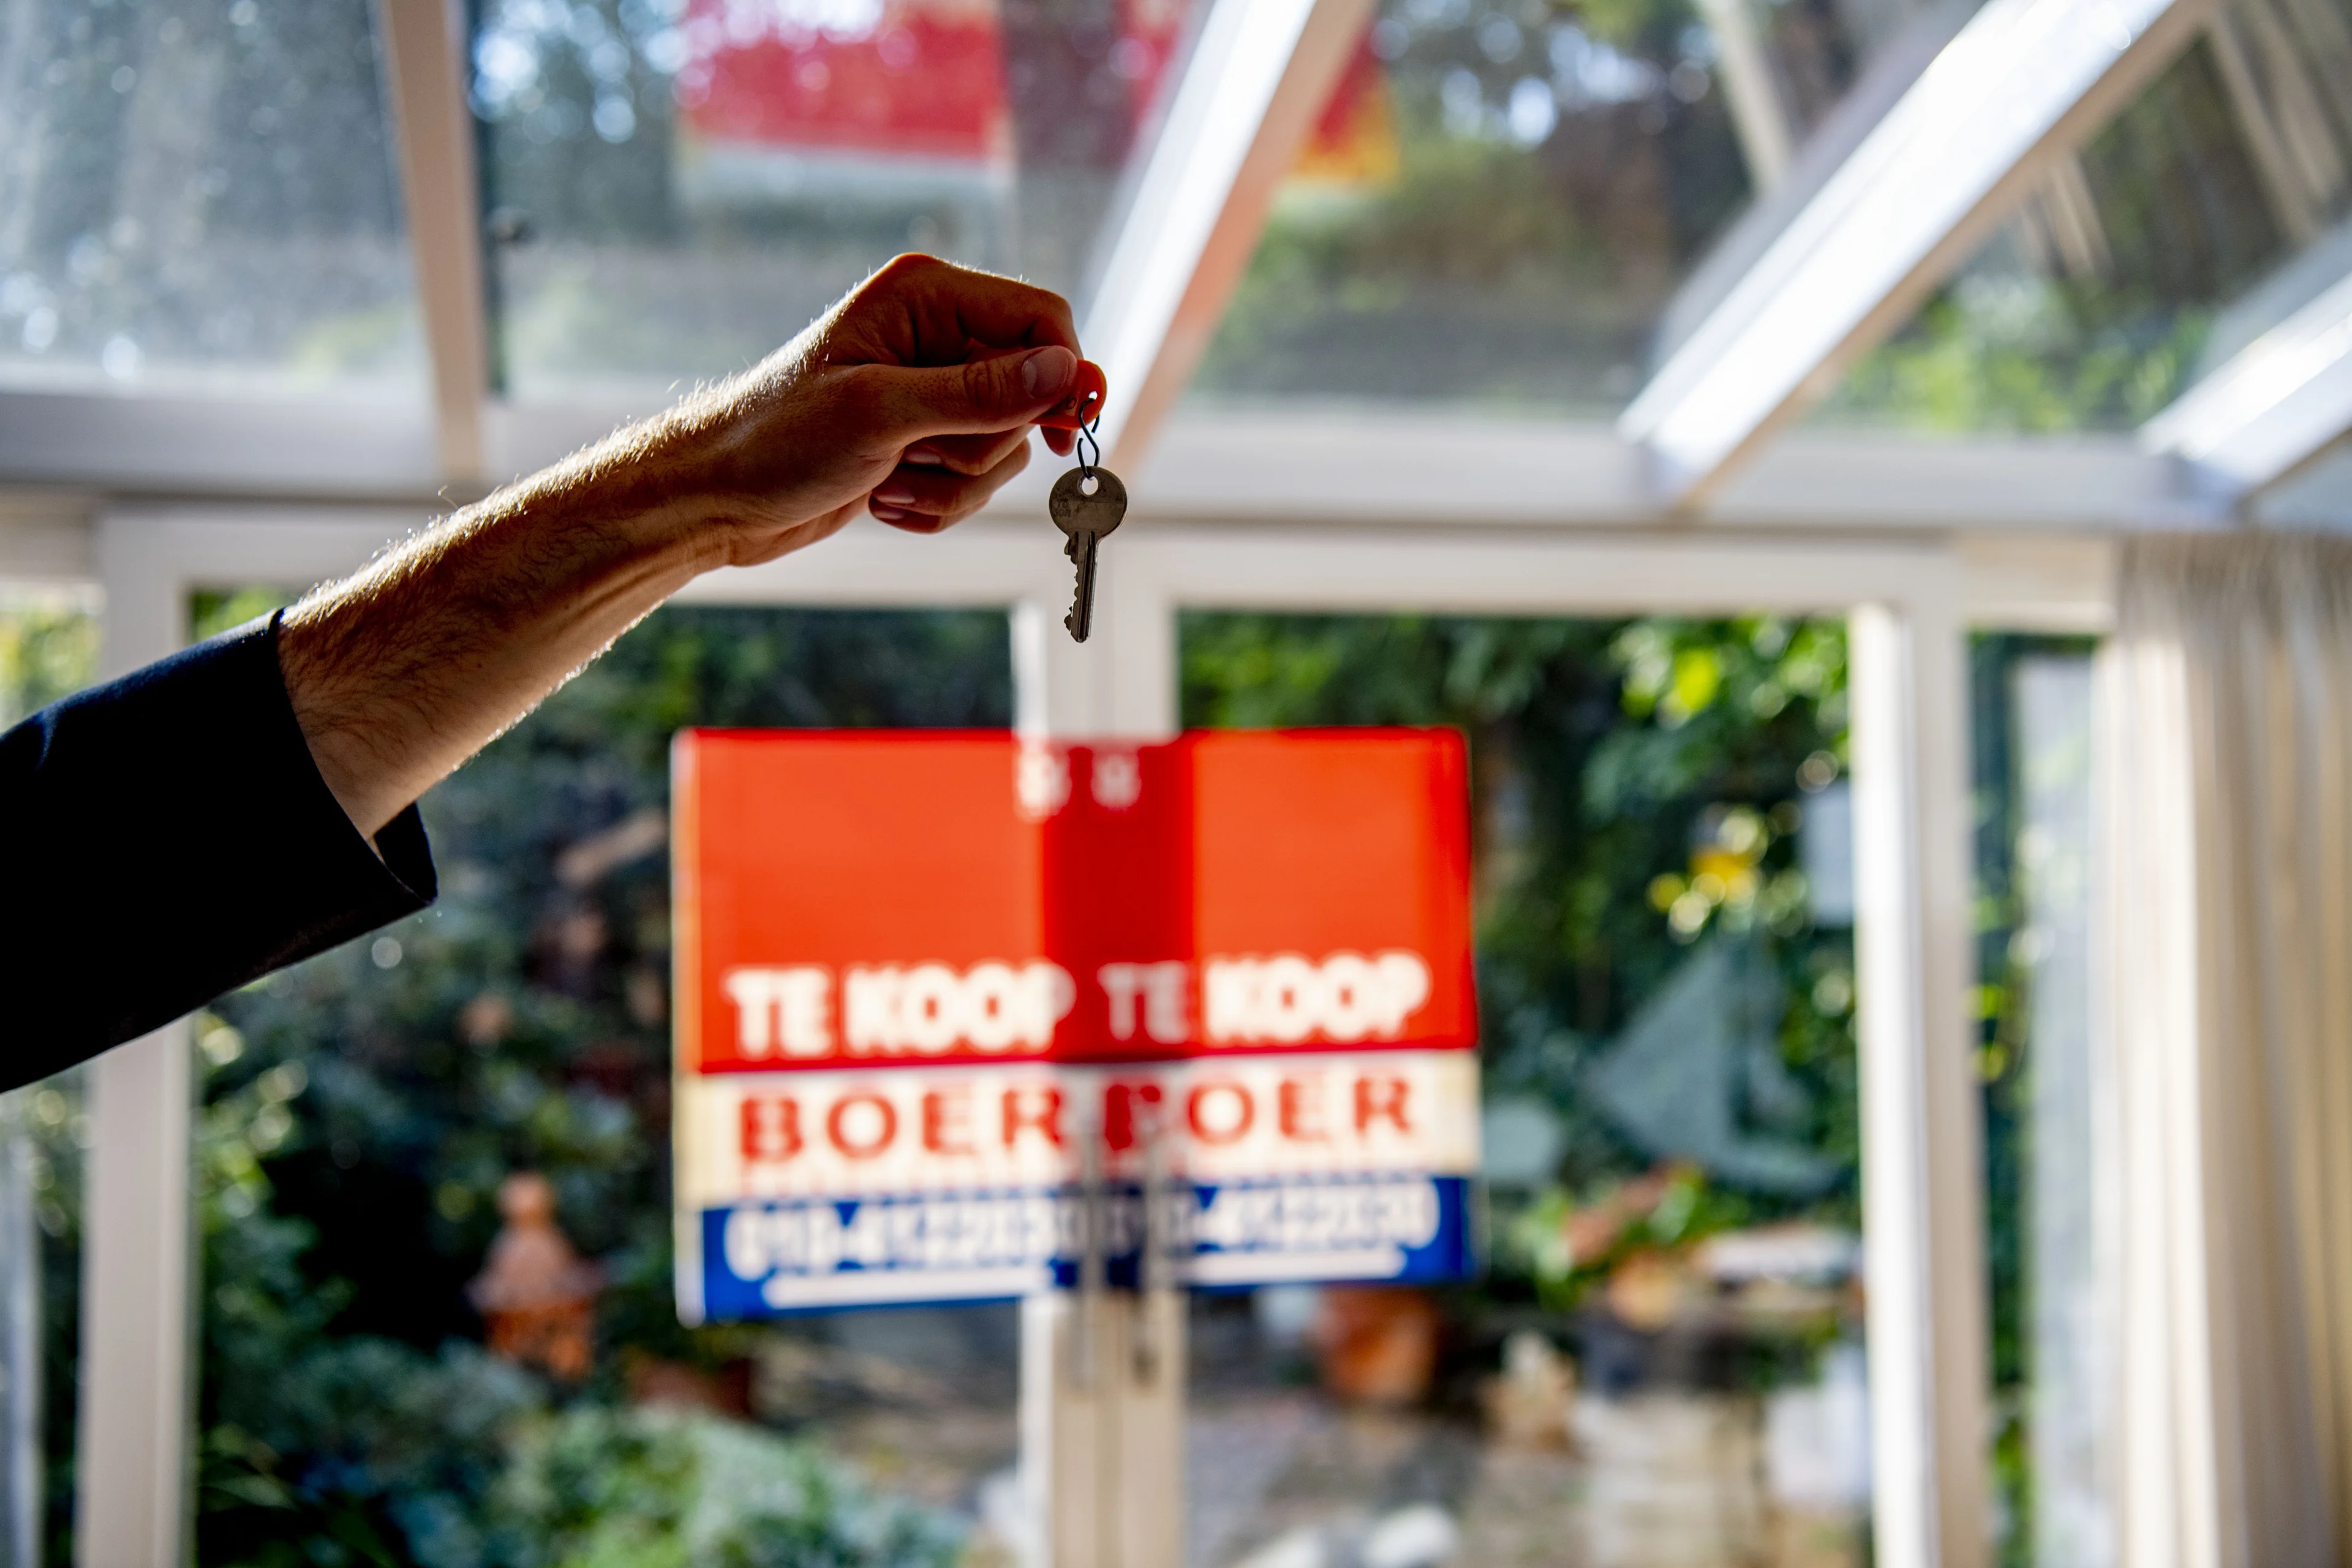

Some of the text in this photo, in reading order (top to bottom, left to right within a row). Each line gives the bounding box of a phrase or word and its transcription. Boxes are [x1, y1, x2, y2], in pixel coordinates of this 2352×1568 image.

[724, 958, 1076, 1057] TE KOOP
[1099, 951, 1431, 1044] TE KOOP
[738, 1084, 1065, 1161] BOER
